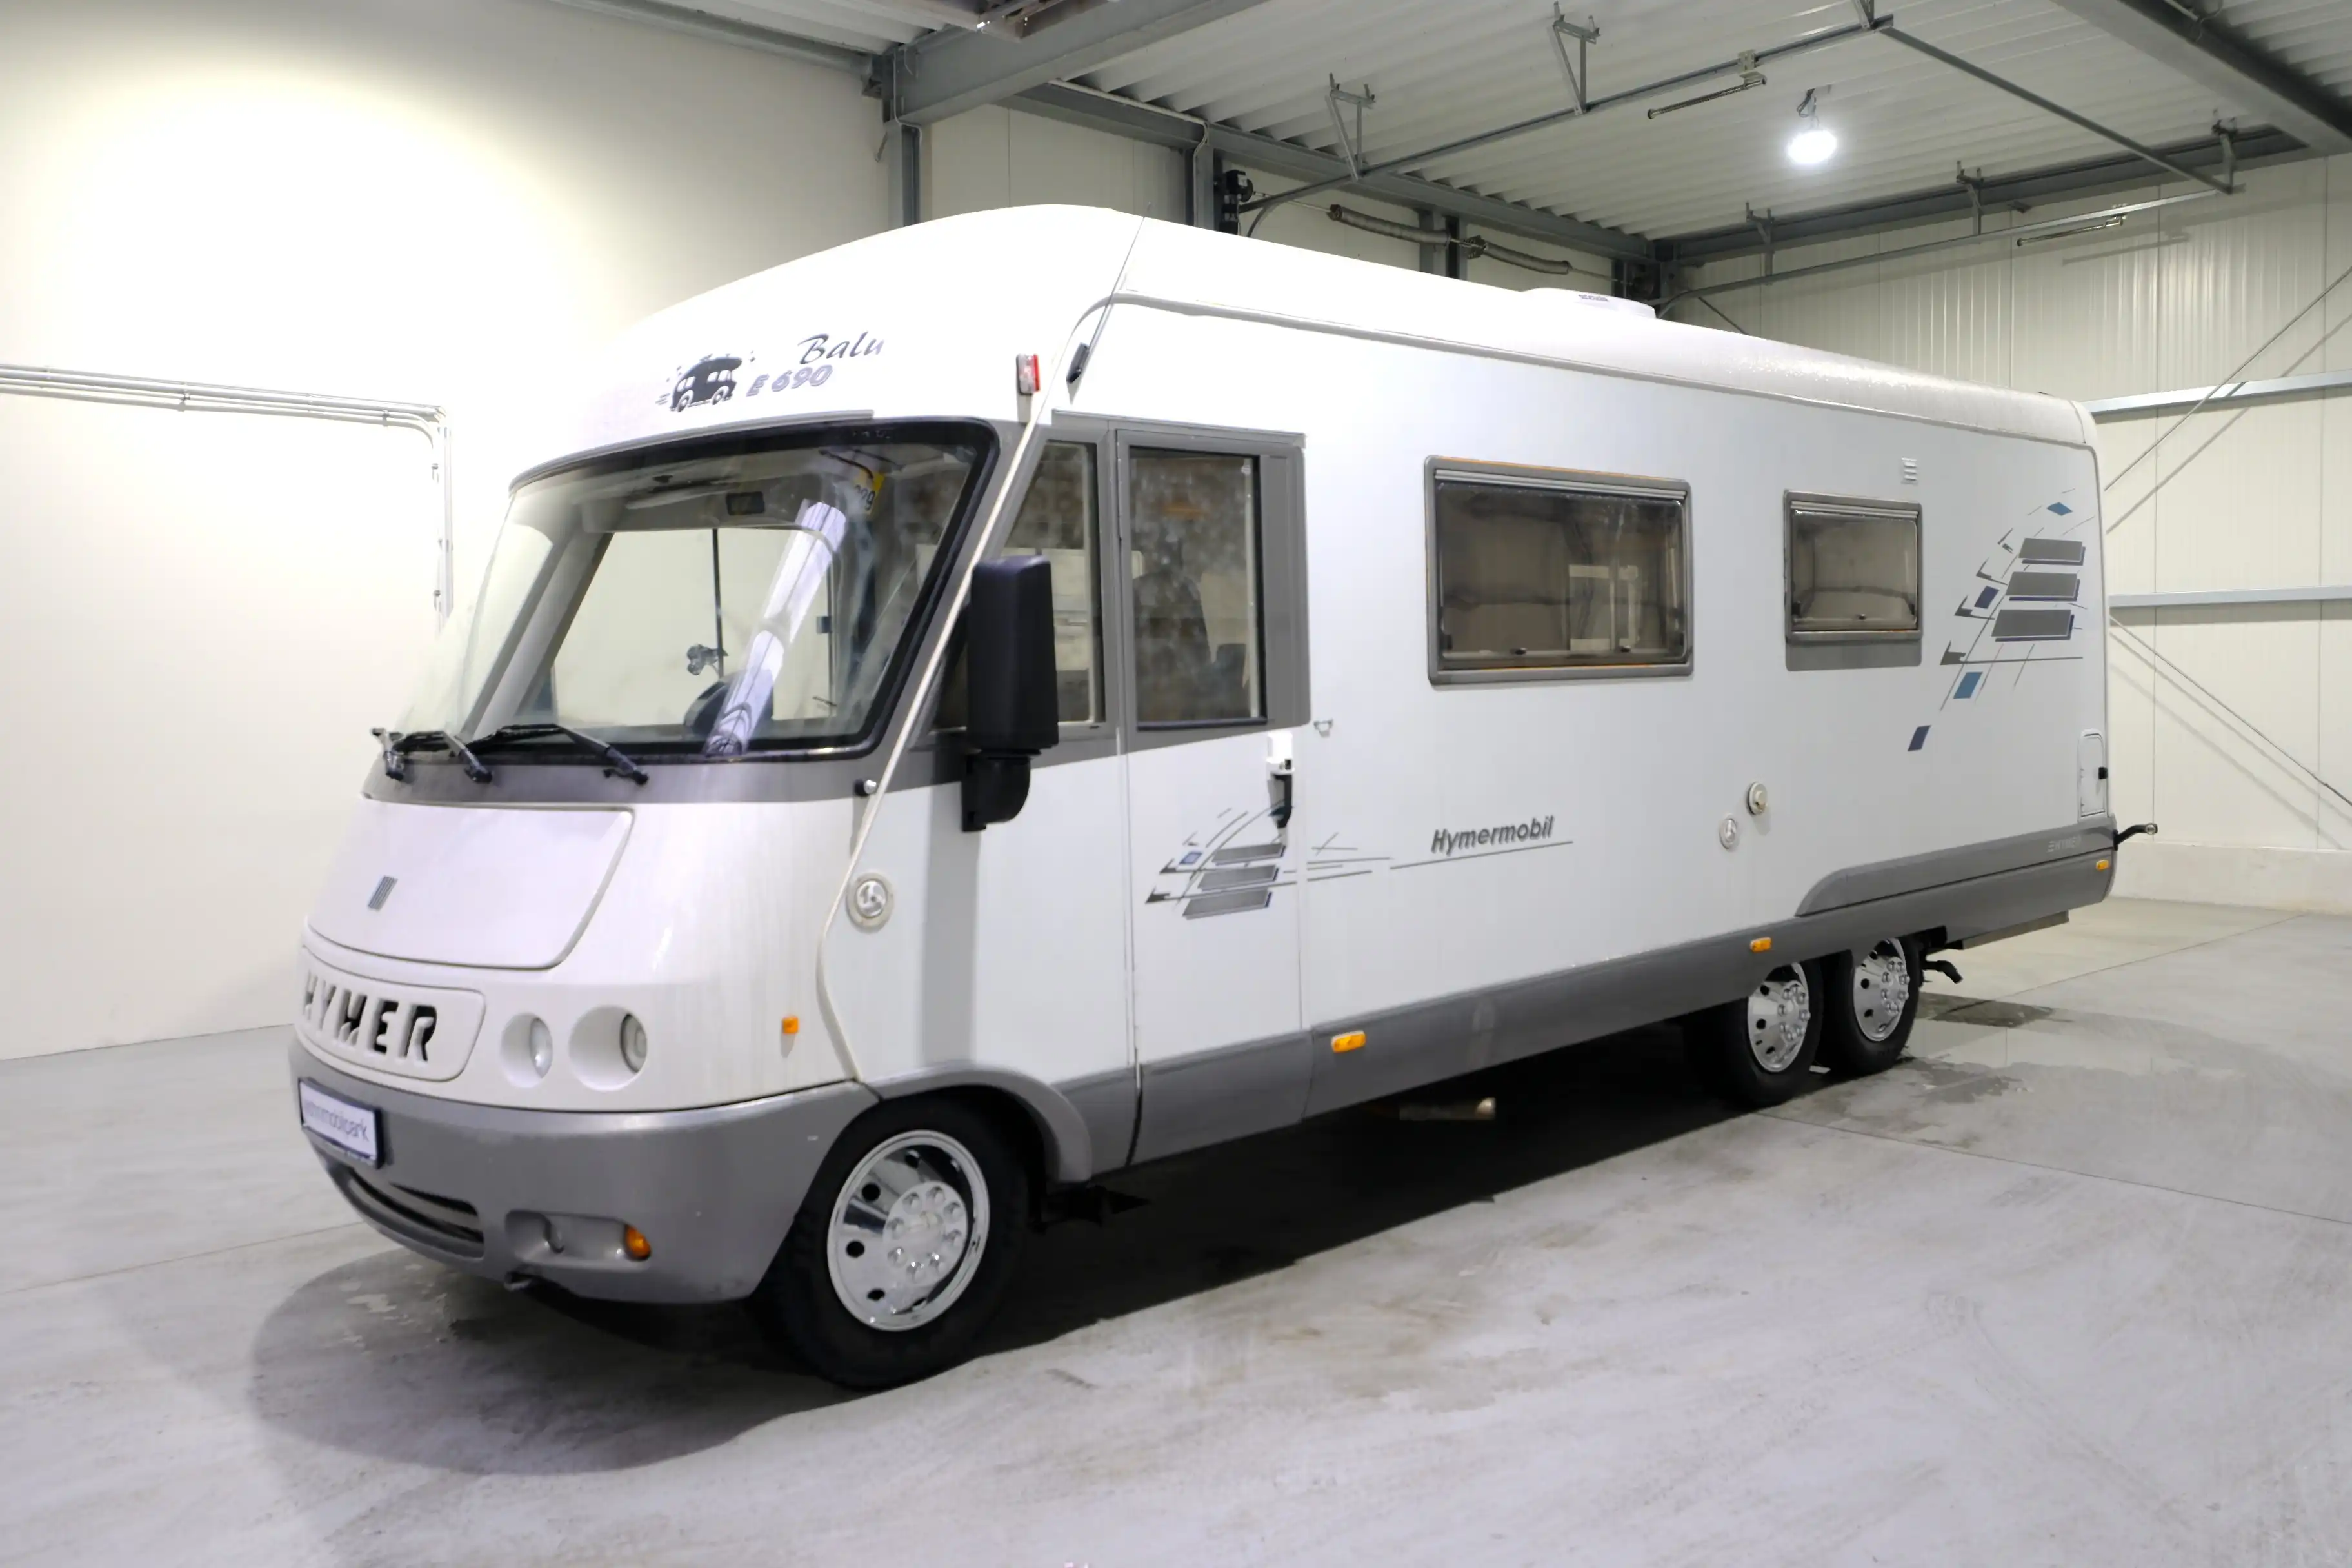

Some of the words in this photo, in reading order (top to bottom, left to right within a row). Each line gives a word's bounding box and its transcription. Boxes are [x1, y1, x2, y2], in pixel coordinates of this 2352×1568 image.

[797, 330, 884, 364] Balu
[745, 373, 770, 397] E
[771, 364, 833, 392] 690
[1430, 815, 1555, 857] Hymermobil
[303, 969, 437, 1062] HYMER
